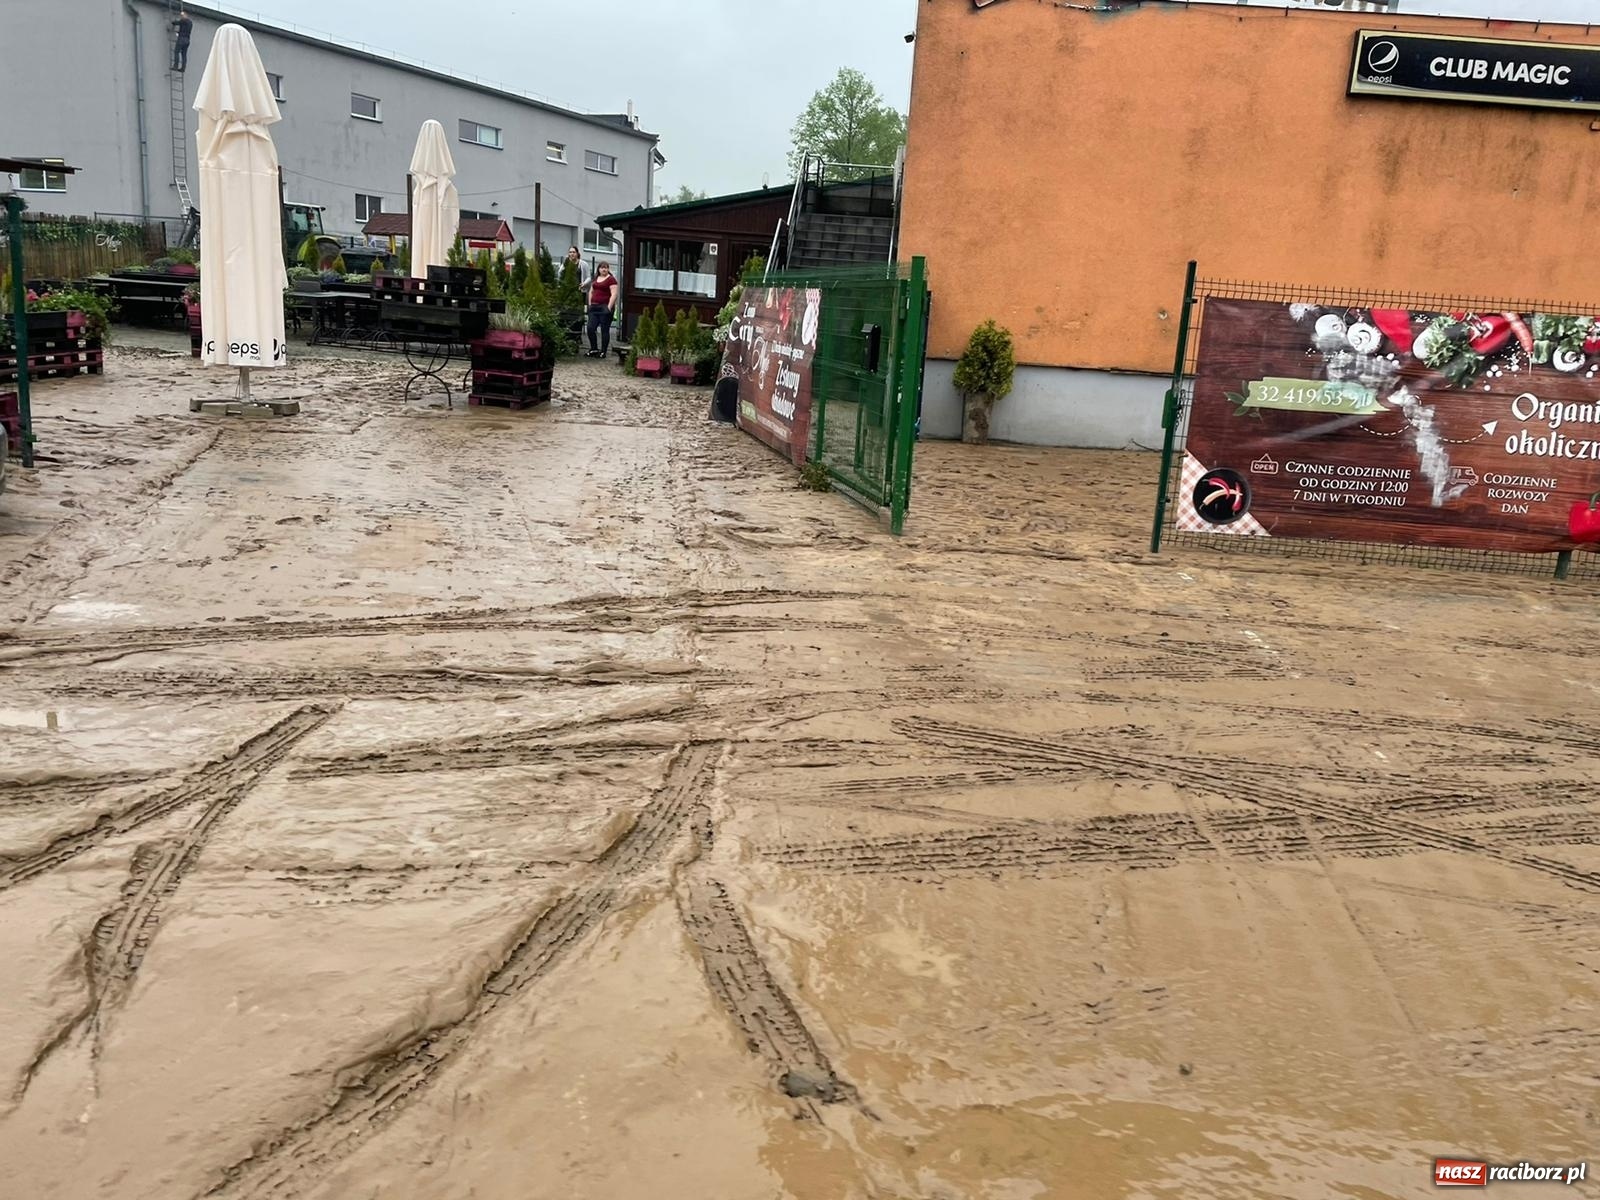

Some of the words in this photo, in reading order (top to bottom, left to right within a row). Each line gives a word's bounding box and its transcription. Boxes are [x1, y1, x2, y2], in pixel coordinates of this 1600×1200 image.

[1429, 56, 1488, 79] CLUB
[1491, 61, 1572, 86] MAGIC
[1257, 386, 1279, 402] 32
[1284, 387, 1317, 405] 419
[1321, 390, 1342, 406] 53
[1253, 463, 1275, 471] OPEN
[1285, 461, 1334, 475] CZYNNE
[1336, 465, 1411, 480] CODZIENNIE
[1299, 477, 1318, 488] OD
[1321, 479, 1377, 491] GODZINY
[1380, 481, 1409, 493] 12:00
[1483, 472, 1558, 488] CODZIENNE
[1293, 489, 1301, 500] 7
[1303, 491, 1326, 502] DNI
[1329, 493, 1341, 503] W
[1343, 494, 1406, 507] TYGODNIU
[1487, 488, 1550, 502] ROZWOZY
[1501, 502, 1529, 514] DAŃ
